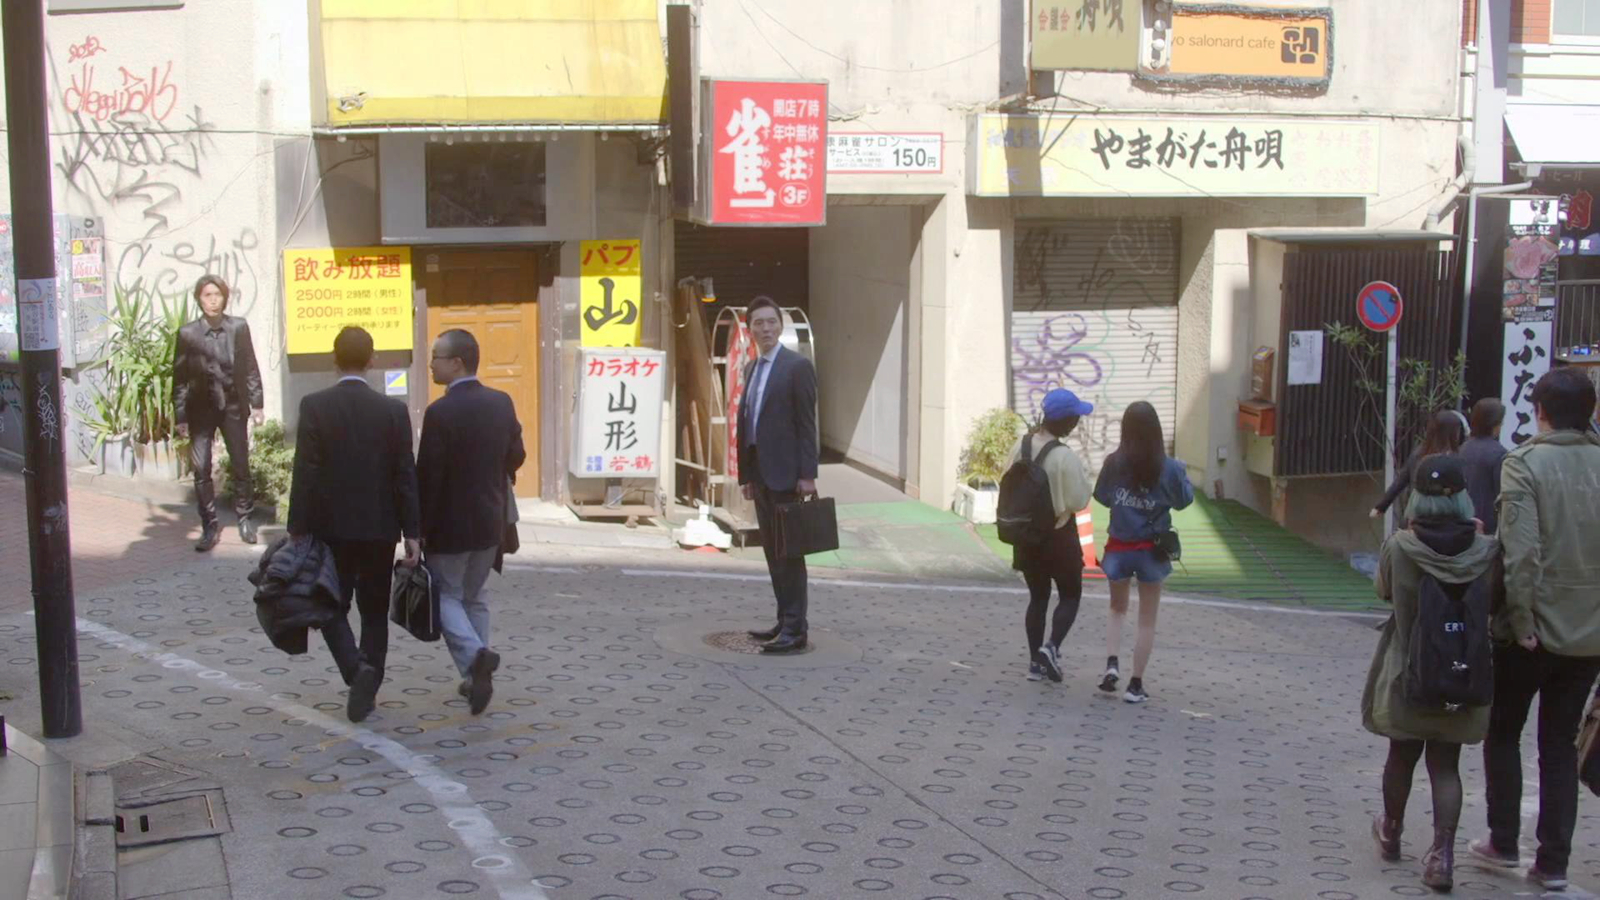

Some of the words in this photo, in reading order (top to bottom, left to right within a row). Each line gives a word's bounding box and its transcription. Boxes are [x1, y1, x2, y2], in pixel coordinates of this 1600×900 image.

[1188, 34, 1244, 48] salonard
[1247, 37, 1276, 49] cafe
[773, 123, 819, 142] 年中無休
[1091, 126, 1285, 171] やまがた舟唄
[783, 185, 807, 204] 3F
[582, 242, 637, 266] パブ
[293, 254, 401, 282] 飲み放題
[296, 288, 343, 301] 2500円
[297, 305, 344, 319] 2000円
[583, 277, 639, 348] 山
[587, 357, 660, 378] カラオケ
[604, 380, 639, 451] 山形
